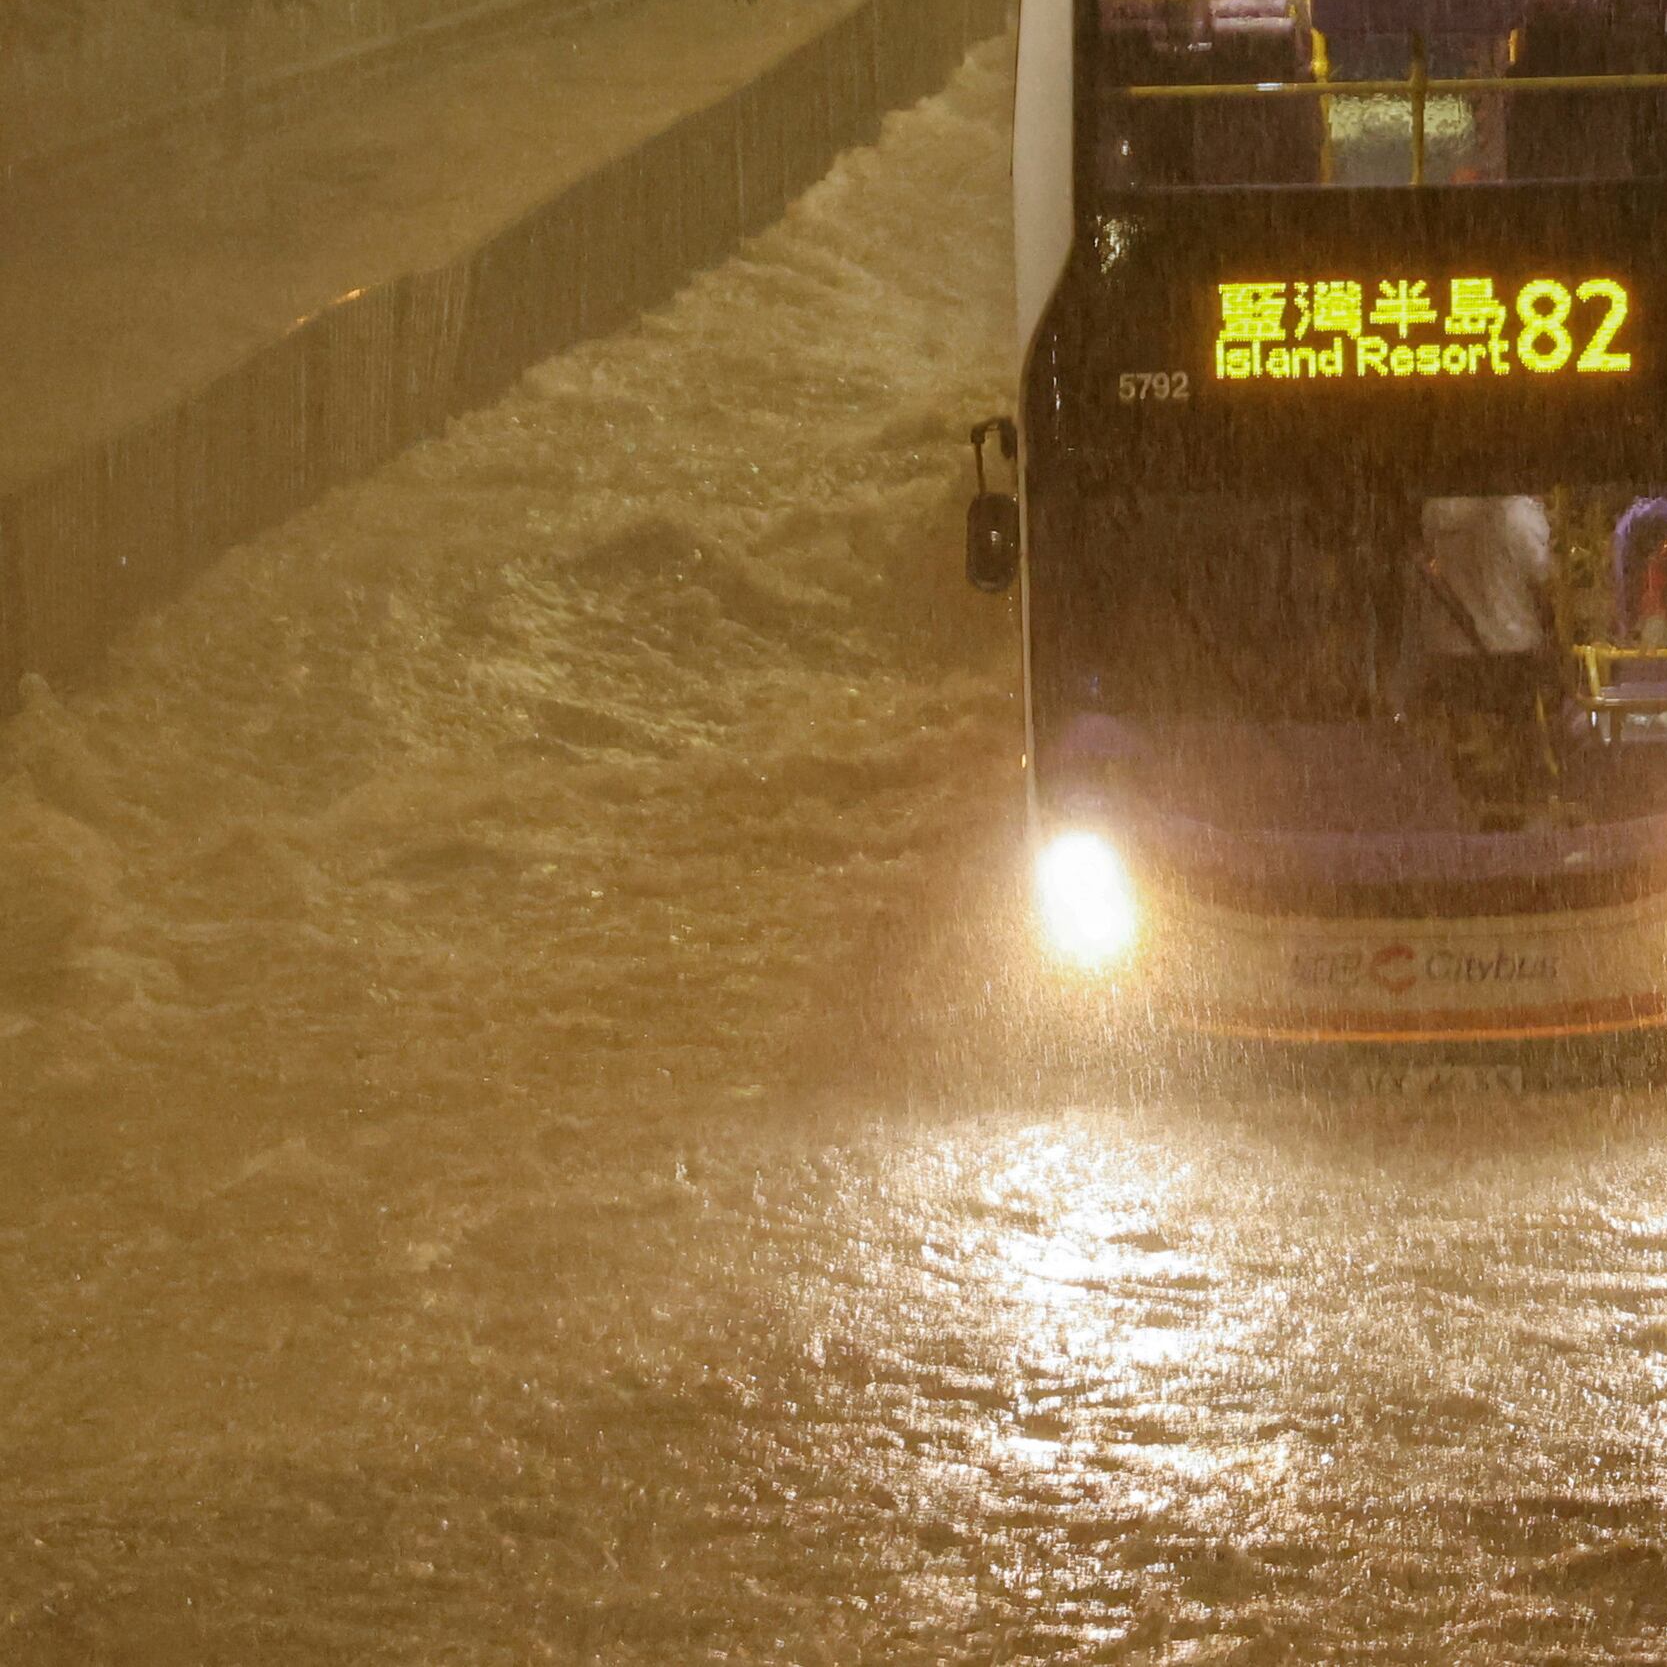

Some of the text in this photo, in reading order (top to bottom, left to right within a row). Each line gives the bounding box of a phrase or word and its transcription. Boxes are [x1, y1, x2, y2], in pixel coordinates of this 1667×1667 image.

[1217, 277, 1507, 341] 藍灣半島
[1516, 277, 1632, 374] 82
[1215, 335, 1510, 380] Island Resort
[1118, 372, 1190, 401] 5792
